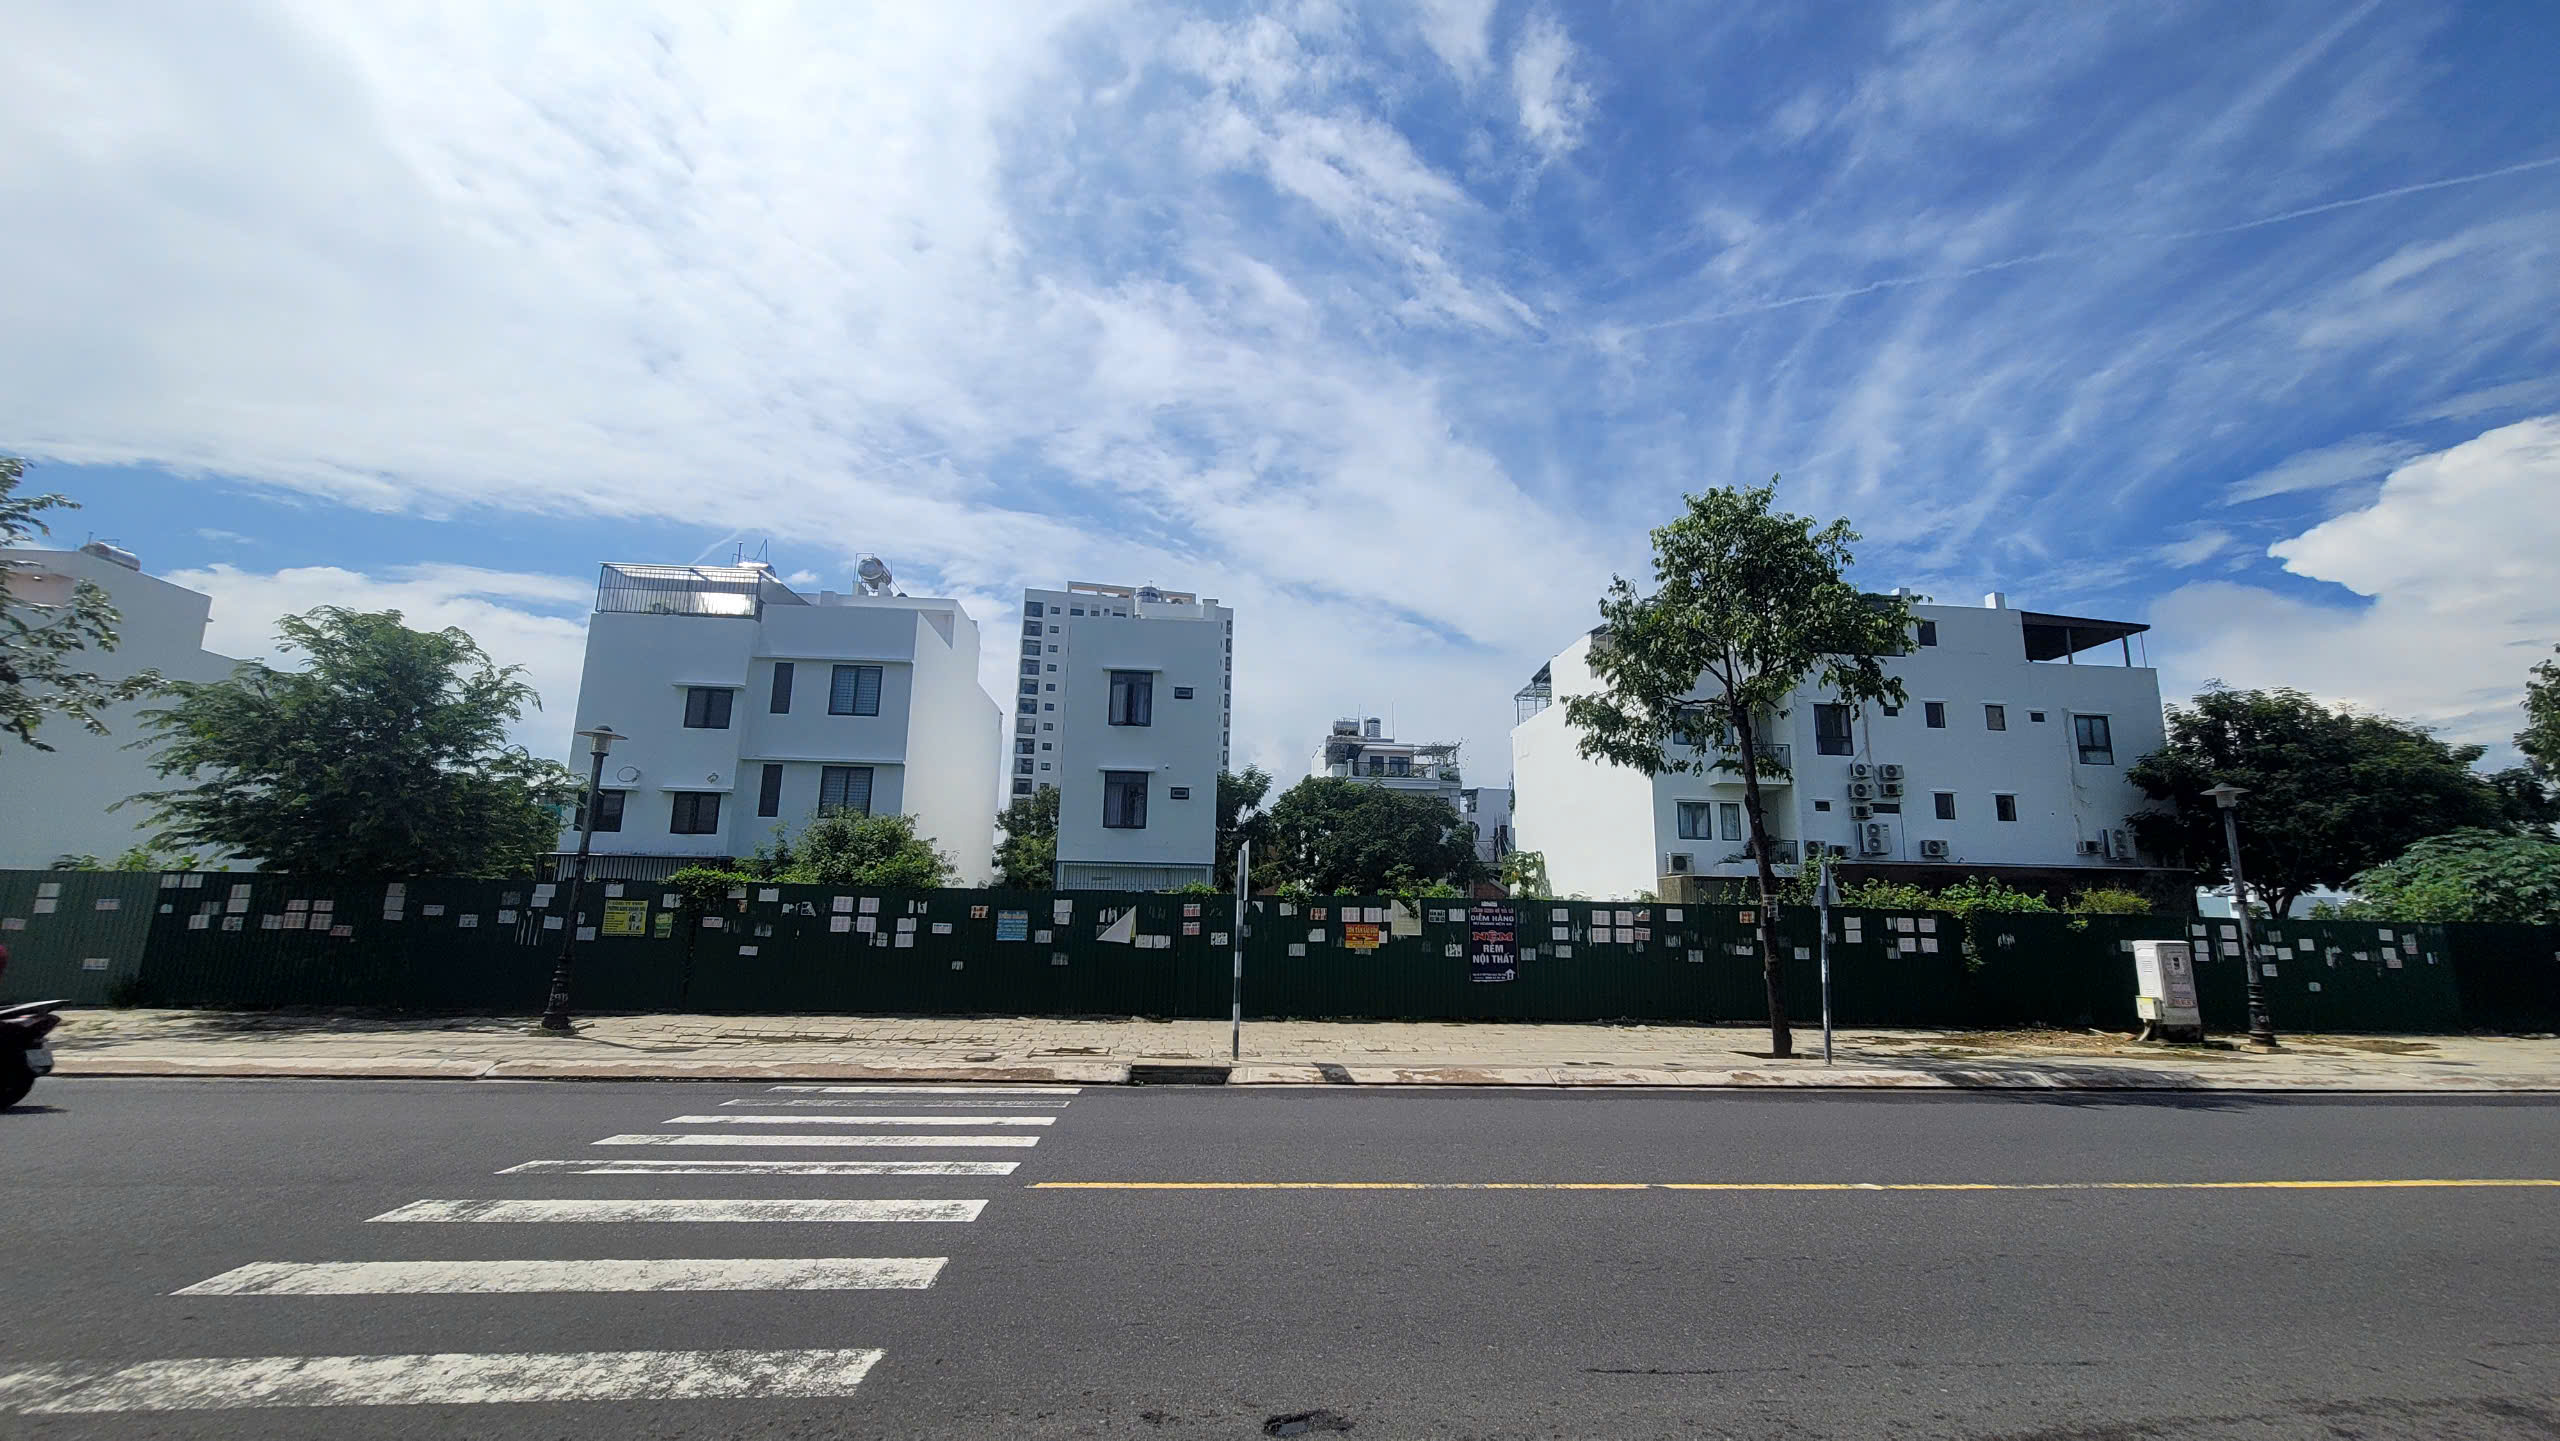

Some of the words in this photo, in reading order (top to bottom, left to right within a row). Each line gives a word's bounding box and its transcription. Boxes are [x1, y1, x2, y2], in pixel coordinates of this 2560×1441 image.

[1472, 930, 1513, 943] NỆM
[1473, 953, 1489, 965] NỘI
[1492, 952, 1514, 964] THẤT
